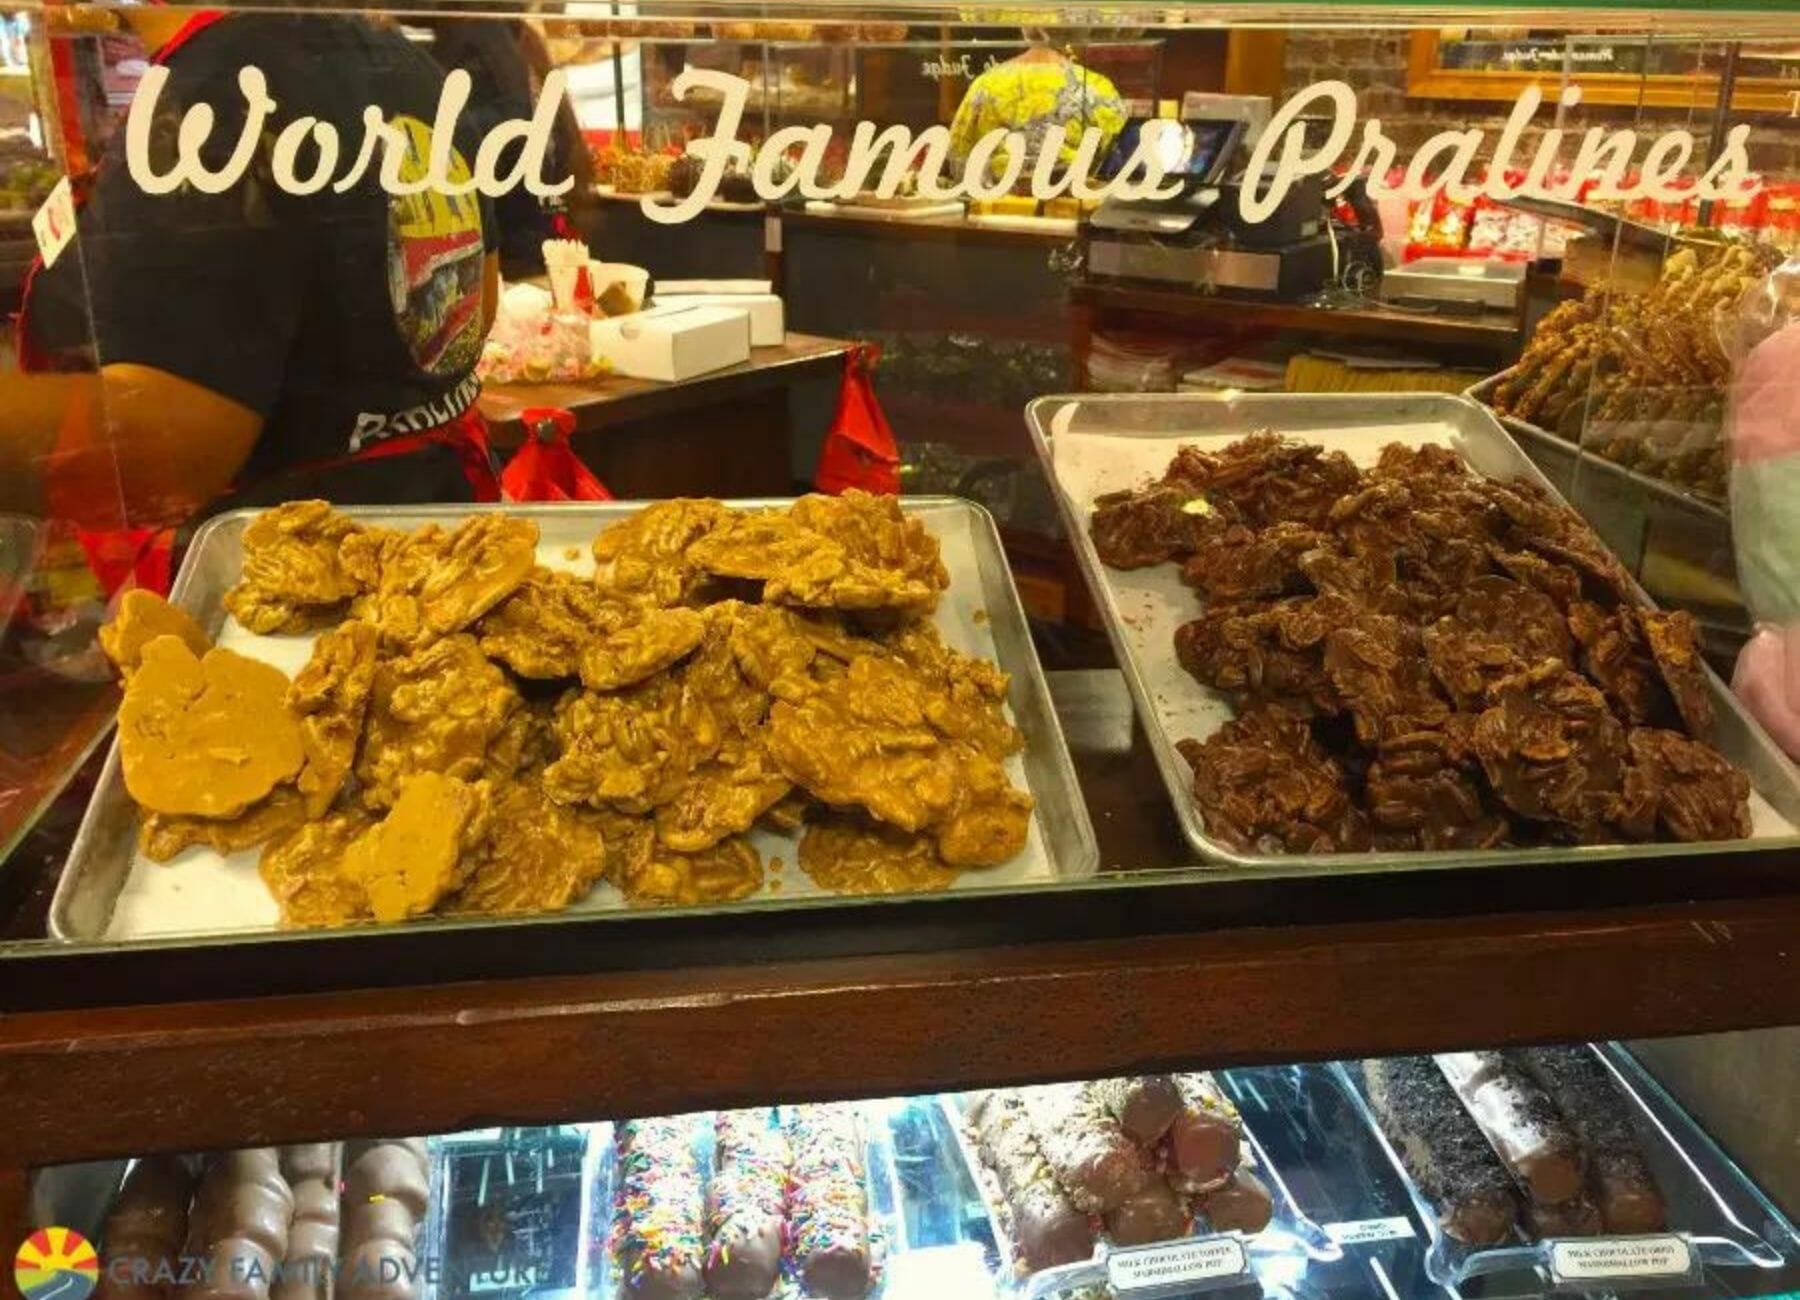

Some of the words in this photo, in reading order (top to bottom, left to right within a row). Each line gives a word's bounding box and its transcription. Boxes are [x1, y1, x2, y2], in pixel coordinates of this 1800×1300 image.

[126, 65, 575, 197] World
[641, 65, 1186, 224] Famous
[1239, 80, 1761, 223] Pralines
